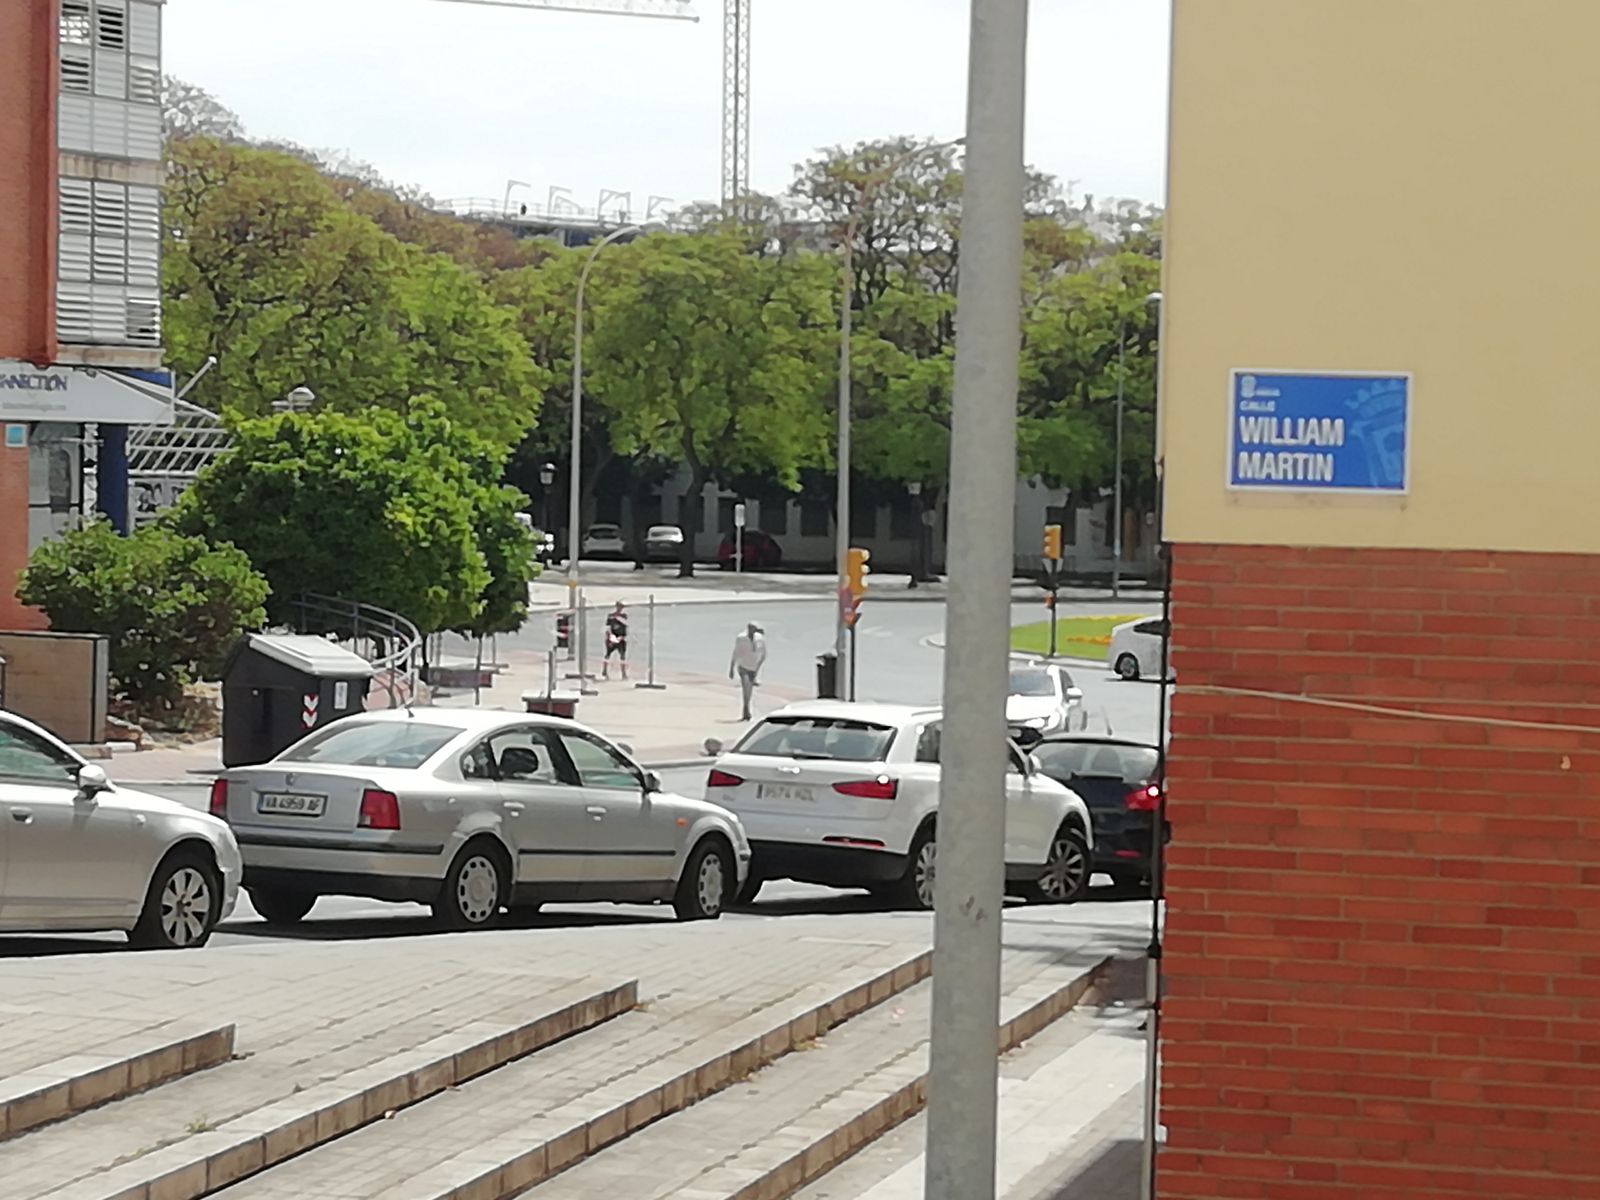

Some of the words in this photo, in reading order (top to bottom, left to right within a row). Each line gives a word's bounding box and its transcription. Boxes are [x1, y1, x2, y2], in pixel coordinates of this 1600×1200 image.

[1239, 400, 1275, 412] CALLE
[1239, 416, 1344, 446] WILLIAM
[1238, 452, 1333, 482] MARTIN
